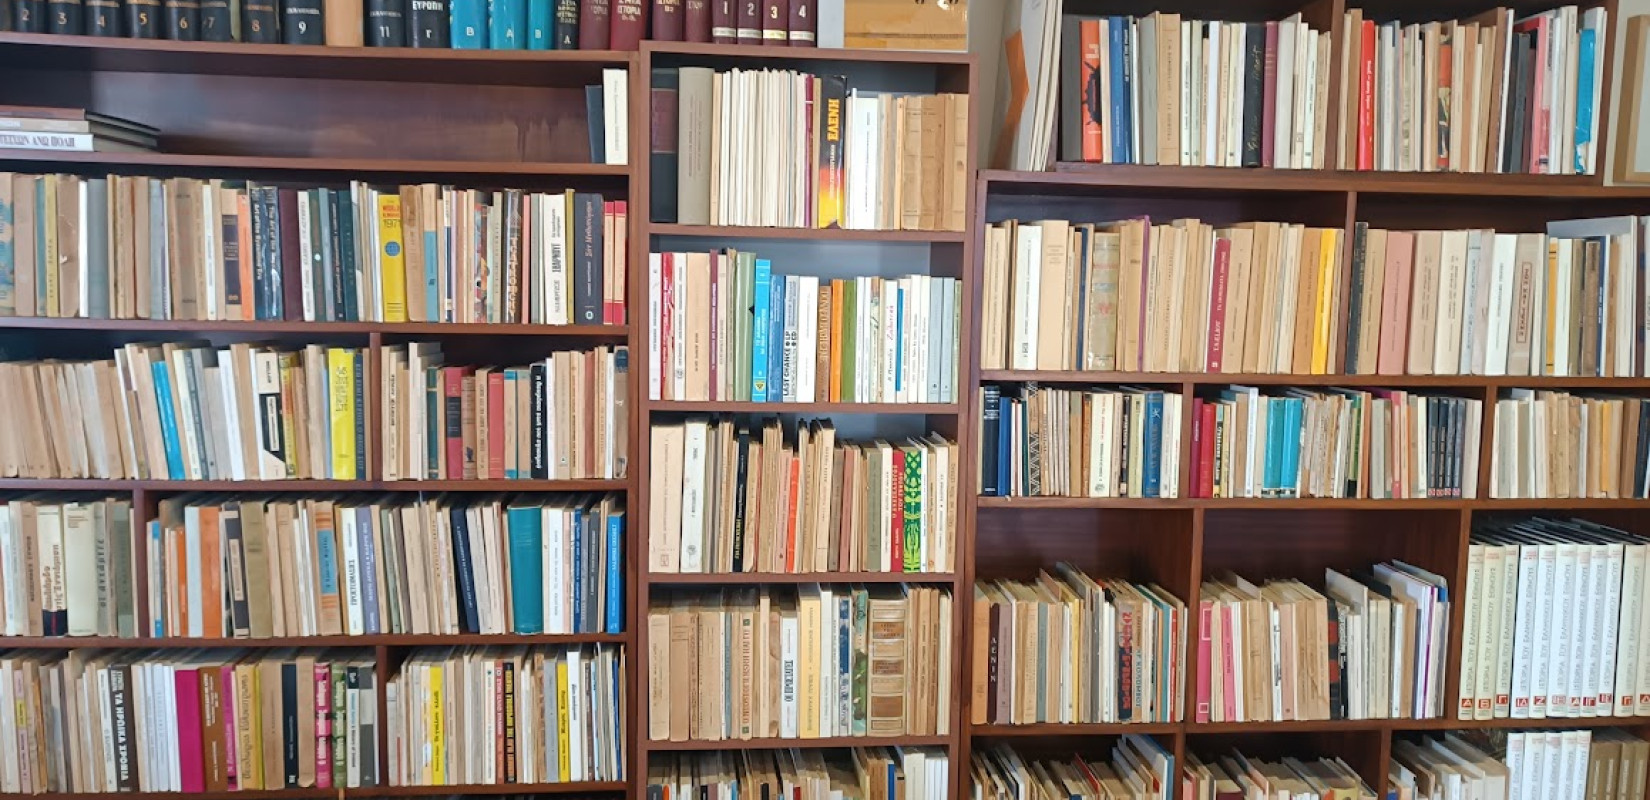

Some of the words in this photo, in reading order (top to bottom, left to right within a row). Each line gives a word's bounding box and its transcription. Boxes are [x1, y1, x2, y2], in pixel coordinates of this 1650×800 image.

[723, 1, 728, 14] 1
[747, 3, 754, 16] 2
[771, 6, 778, 19] 3
[798, 4, 806, 17] 4
[58, 12, 67, 25] 3
[97, 15, 105, 27] 4
[138, 13, 147, 25] 5
[180, 17, 188, 29] 6
[251, 20, 259, 32] 8
[298, 21, 307, 34] 9
[380, 25, 390, 37] 11
[827, 98, 840, 141] ΕΛΕΝΗ
[114, 692, 123, 705] ΤΑ
